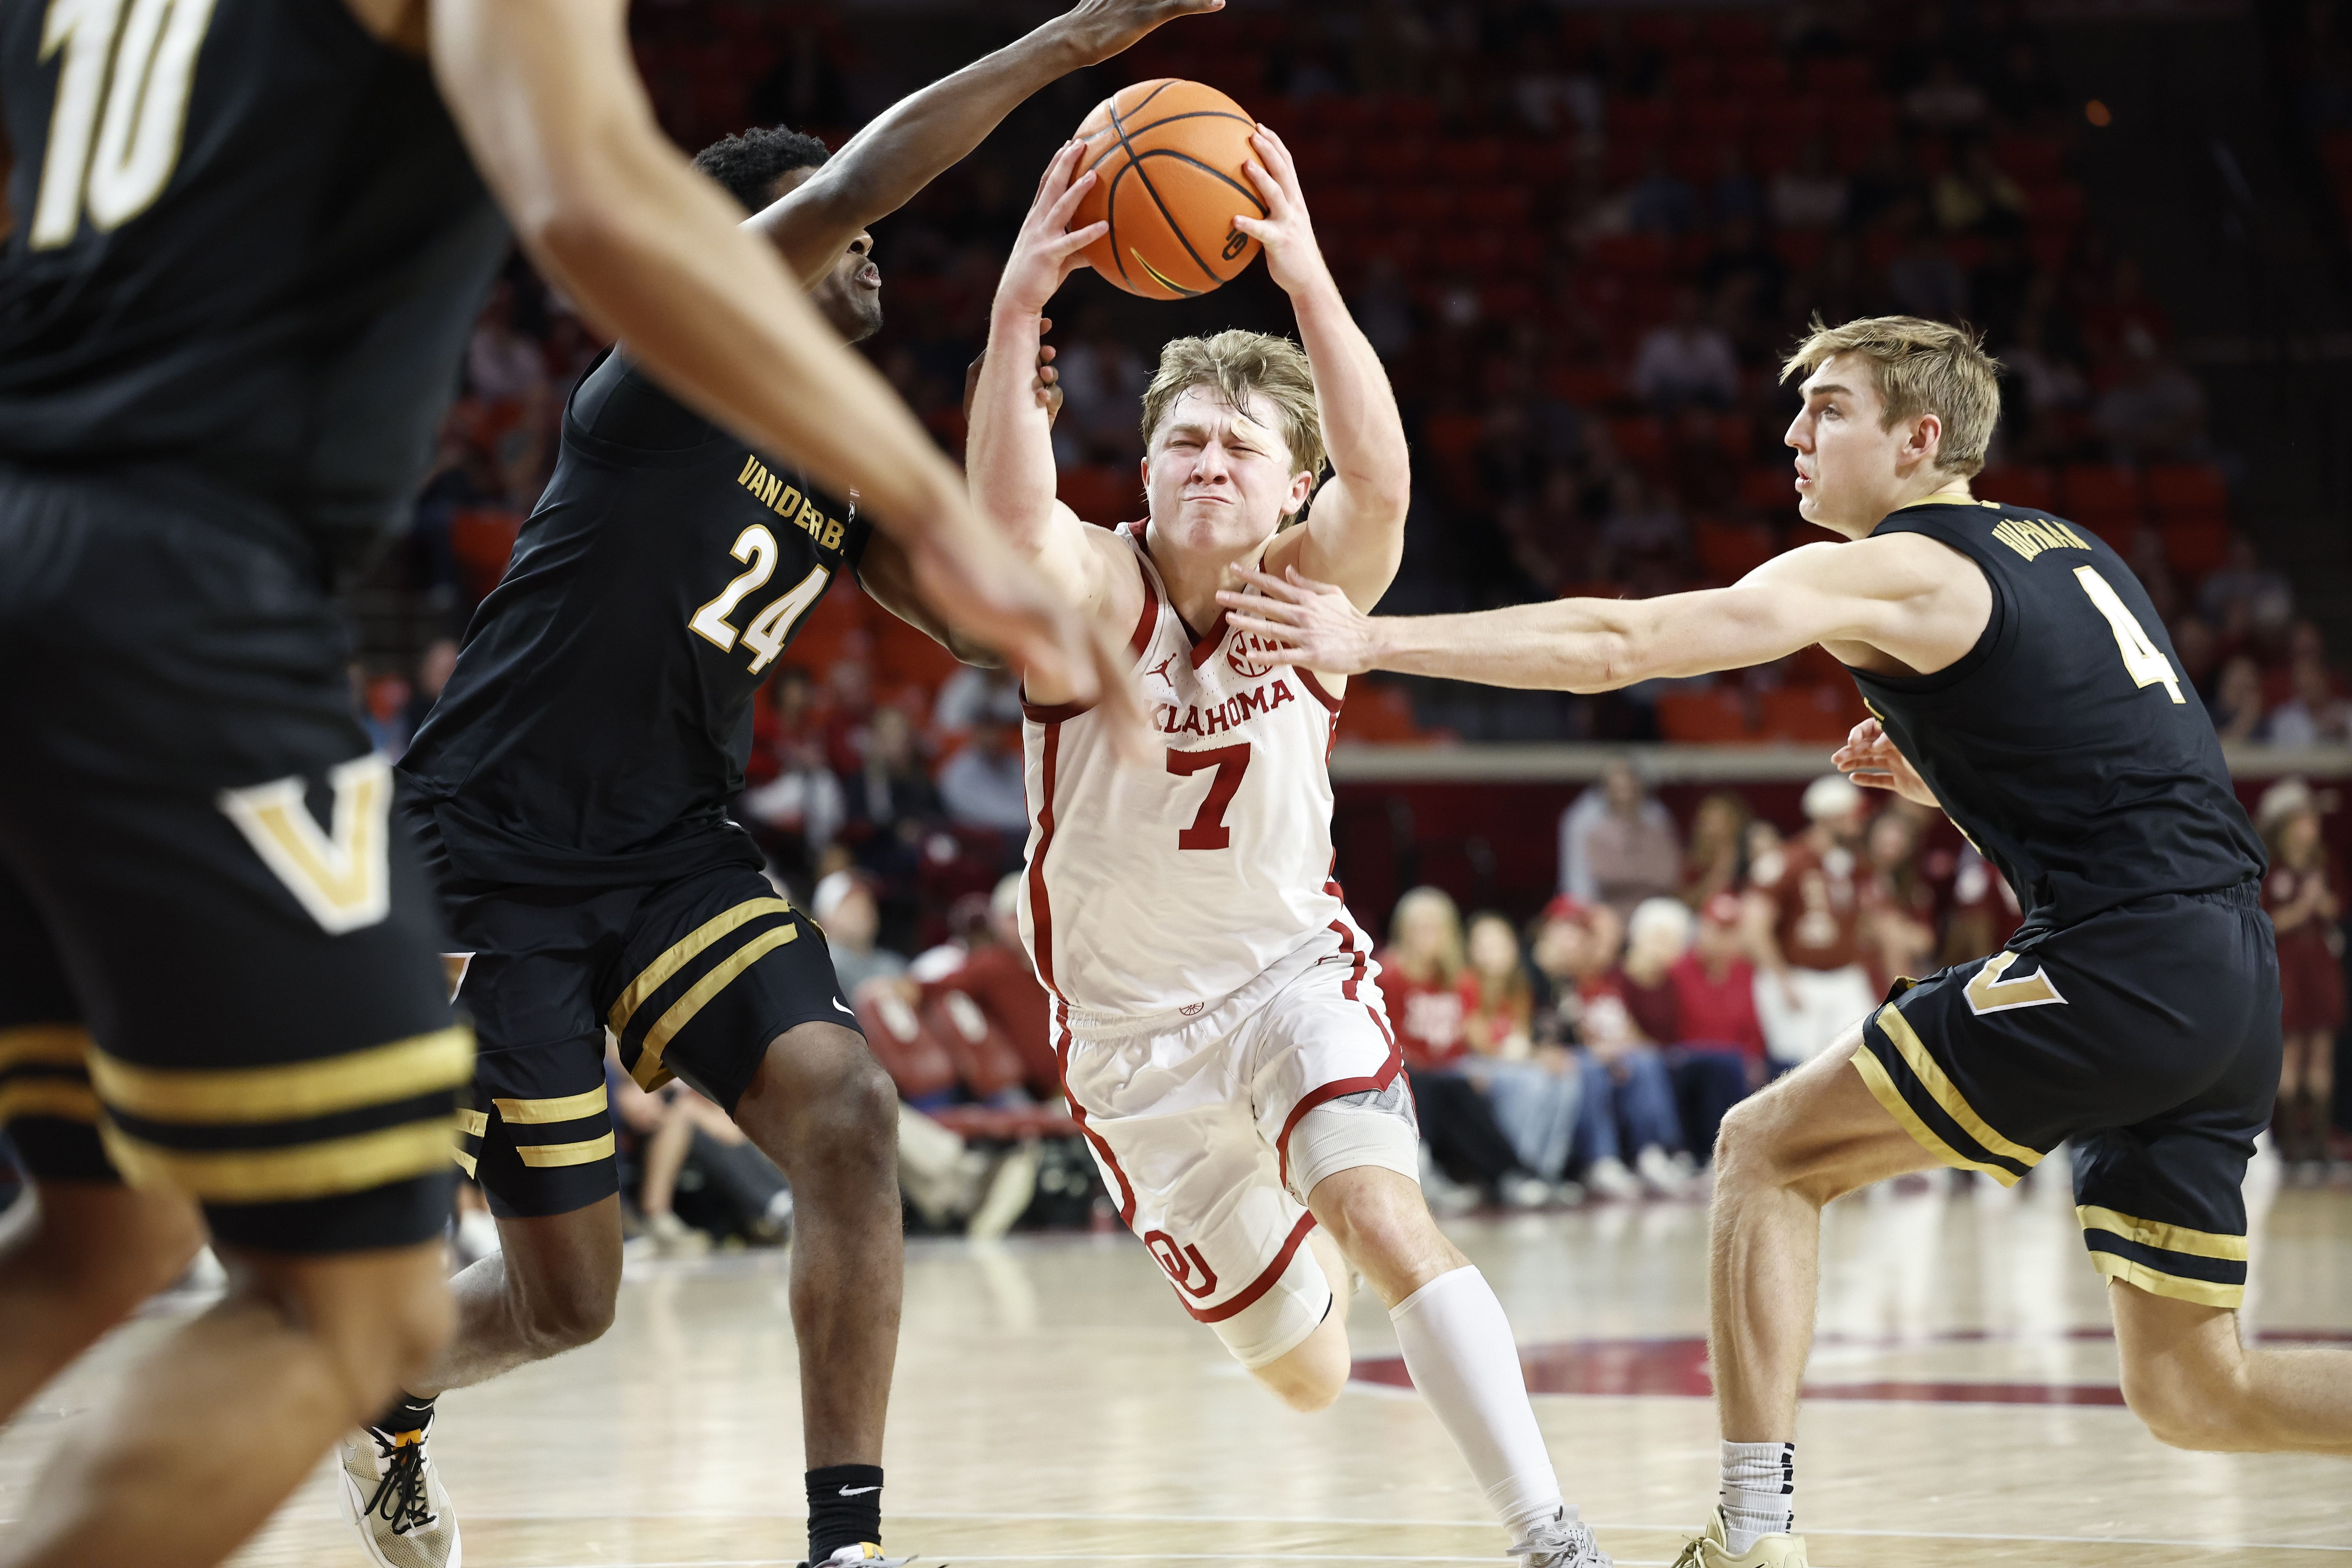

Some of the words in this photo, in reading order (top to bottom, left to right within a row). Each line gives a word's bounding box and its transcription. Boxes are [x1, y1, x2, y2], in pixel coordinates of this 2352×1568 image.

[28, 0, 218, 251] 10
[737, 454, 845, 556] VANDERB
[688, 524, 830, 675] 24
[2072, 565, 2187, 704] 4
[1143, 679, 1295, 737] KLAHOMA
[215, 752, 395, 936] V
[1166, 742, 1251, 851] 7
[1144, 1229, 1218, 1298] OU
